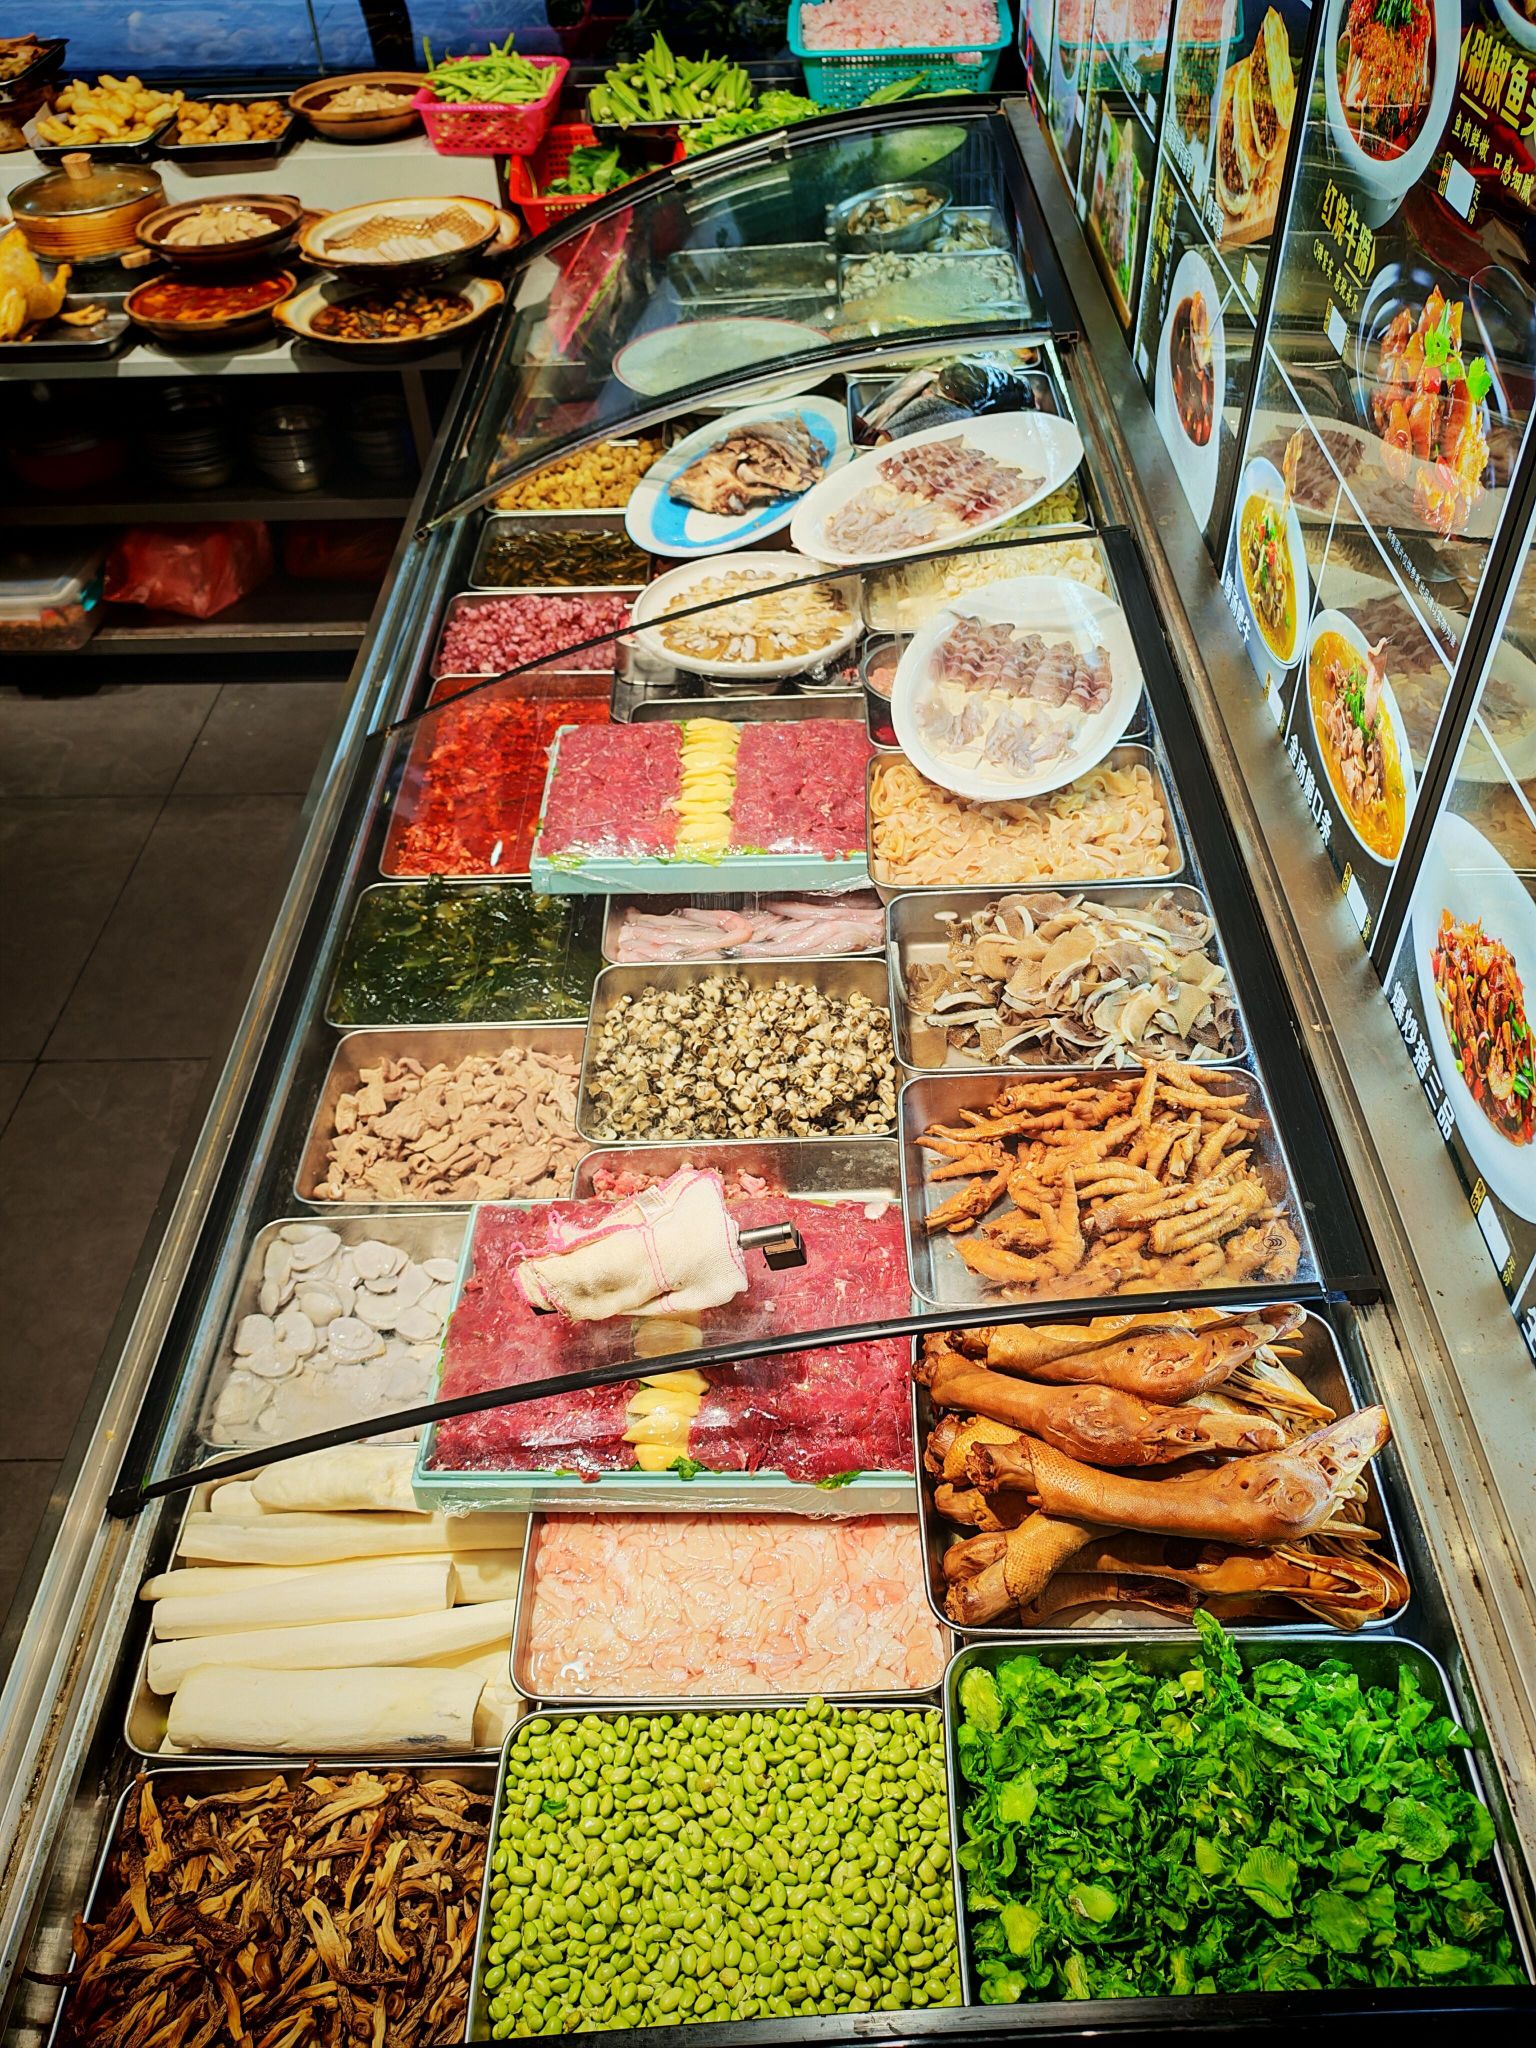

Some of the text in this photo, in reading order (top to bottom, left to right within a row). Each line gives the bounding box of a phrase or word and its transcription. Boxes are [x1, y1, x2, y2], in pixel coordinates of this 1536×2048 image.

[1321, 178, 1373, 277] 红烧牛蹄
[1288, 733, 1333, 847] 金汤脆口条
[1389, 981, 1456, 1141] 爆炒猪三品
